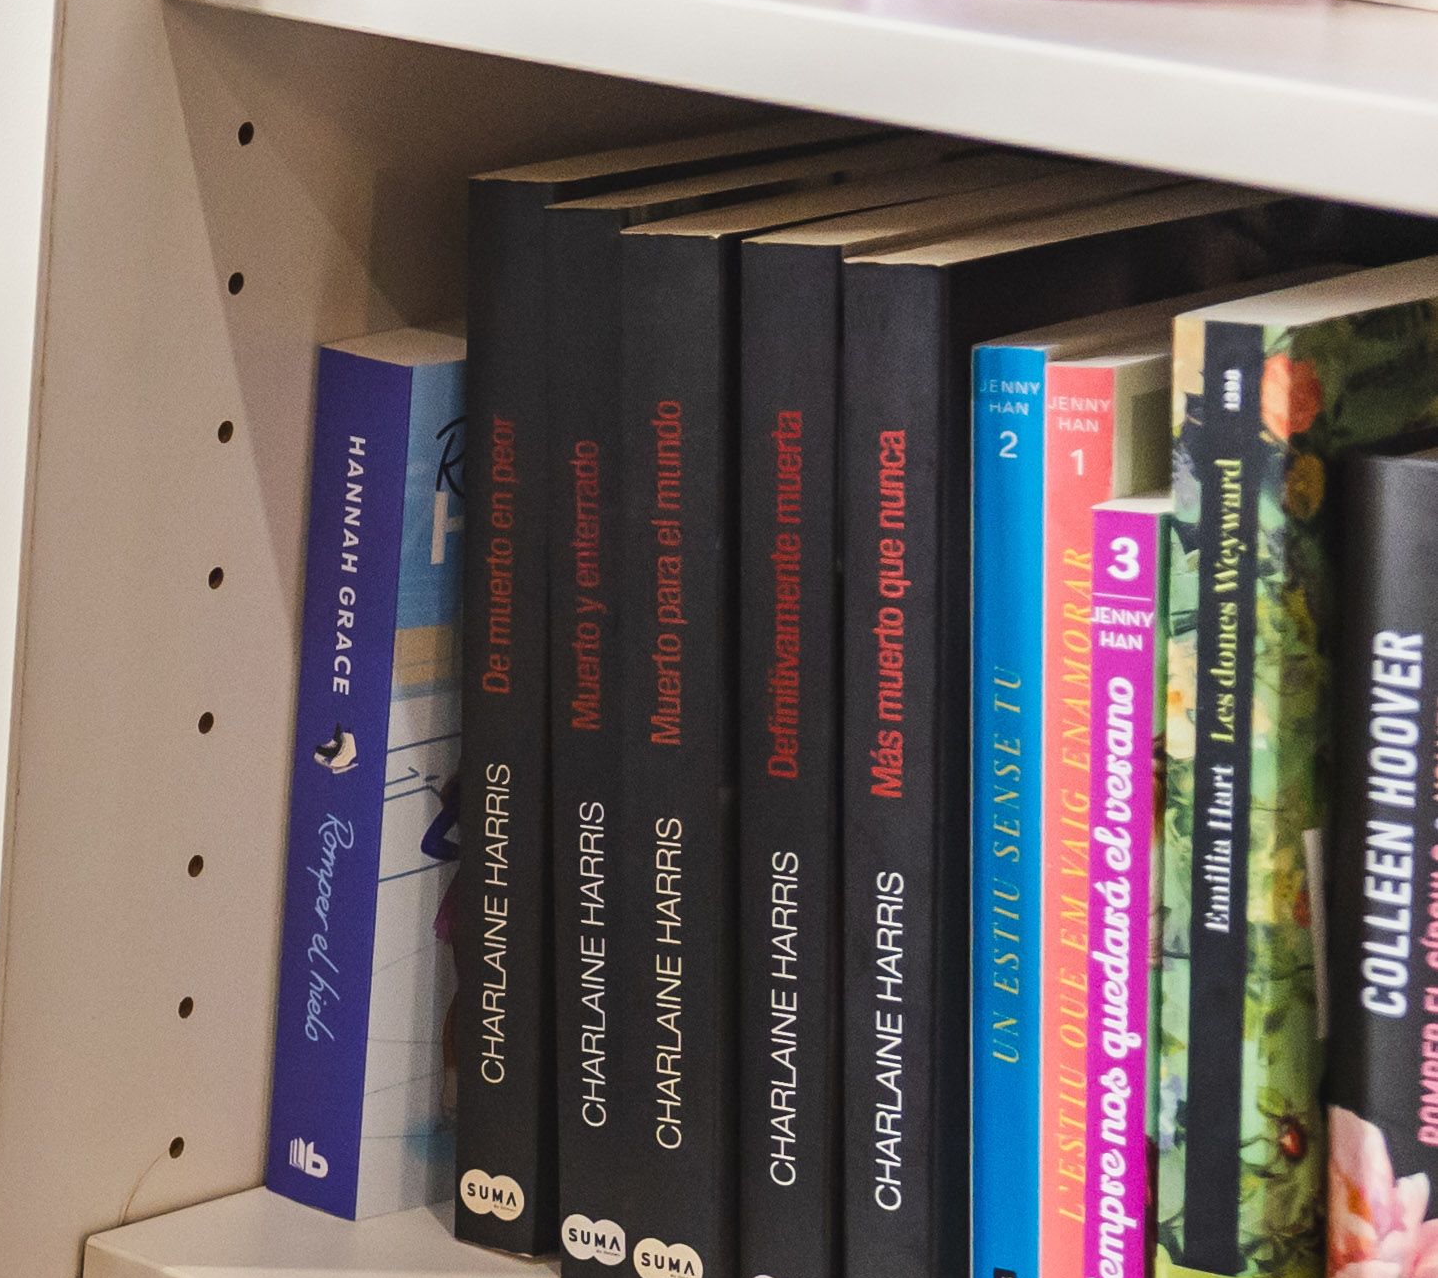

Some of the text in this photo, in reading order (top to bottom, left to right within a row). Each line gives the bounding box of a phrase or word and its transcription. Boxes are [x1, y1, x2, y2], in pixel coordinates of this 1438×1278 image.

[998, 431, 1020, 459] 2
[1057, 416, 1101, 434] HAN
[1070, 449, 1087, 476] 1
[332, 435, 366, 696] HANNAH GRACE
[651, 399, 689, 746] Muerto para mundo
[870, 430, 913, 800] Más muerto que nunca
[1090, 606, 1154, 627] JENNY
[1100, 631, 1143, 651] HAN
[1108, 537, 1139, 581] 3
[1210, 459, 1245, 743] Les dones Weyward
[572, 621, 603, 732] Muerto
[1107, 677, 1134, 813] verano
[1367, 629, 1423, 807] HOOVER
[481, 762, 511, 1085] CHARLAINE HARRIS
[993, 666, 1024, 1064] UN ESTIU SENSE TU
[1057, 547, 1092, 1223] L'ESTIU QUE EM ENAMORAR
[1094, 825, 1131, 871] el
[1204, 764, 1235, 934] Emilia Hart
[1361, 821, 1414, 1018] COLLEEN
[579, 801, 608, 1128] CHARLAINE HARRIS
[655, 817, 683, 1151] CHARLAINE HARRIS
[770, 850, 800, 1187] CHARLAINE HARRIS
[875, 870, 905, 1213] CHARLAINE HARRIS
[1093, 877, 1144, 1060] quedará
[467, 1180, 518, 1208] SUMA
[1100, 1069, 1131, 1147] nos
[569, 1224, 622, 1252] SUMA
[641, 1251, 697, 1278] SUMA
